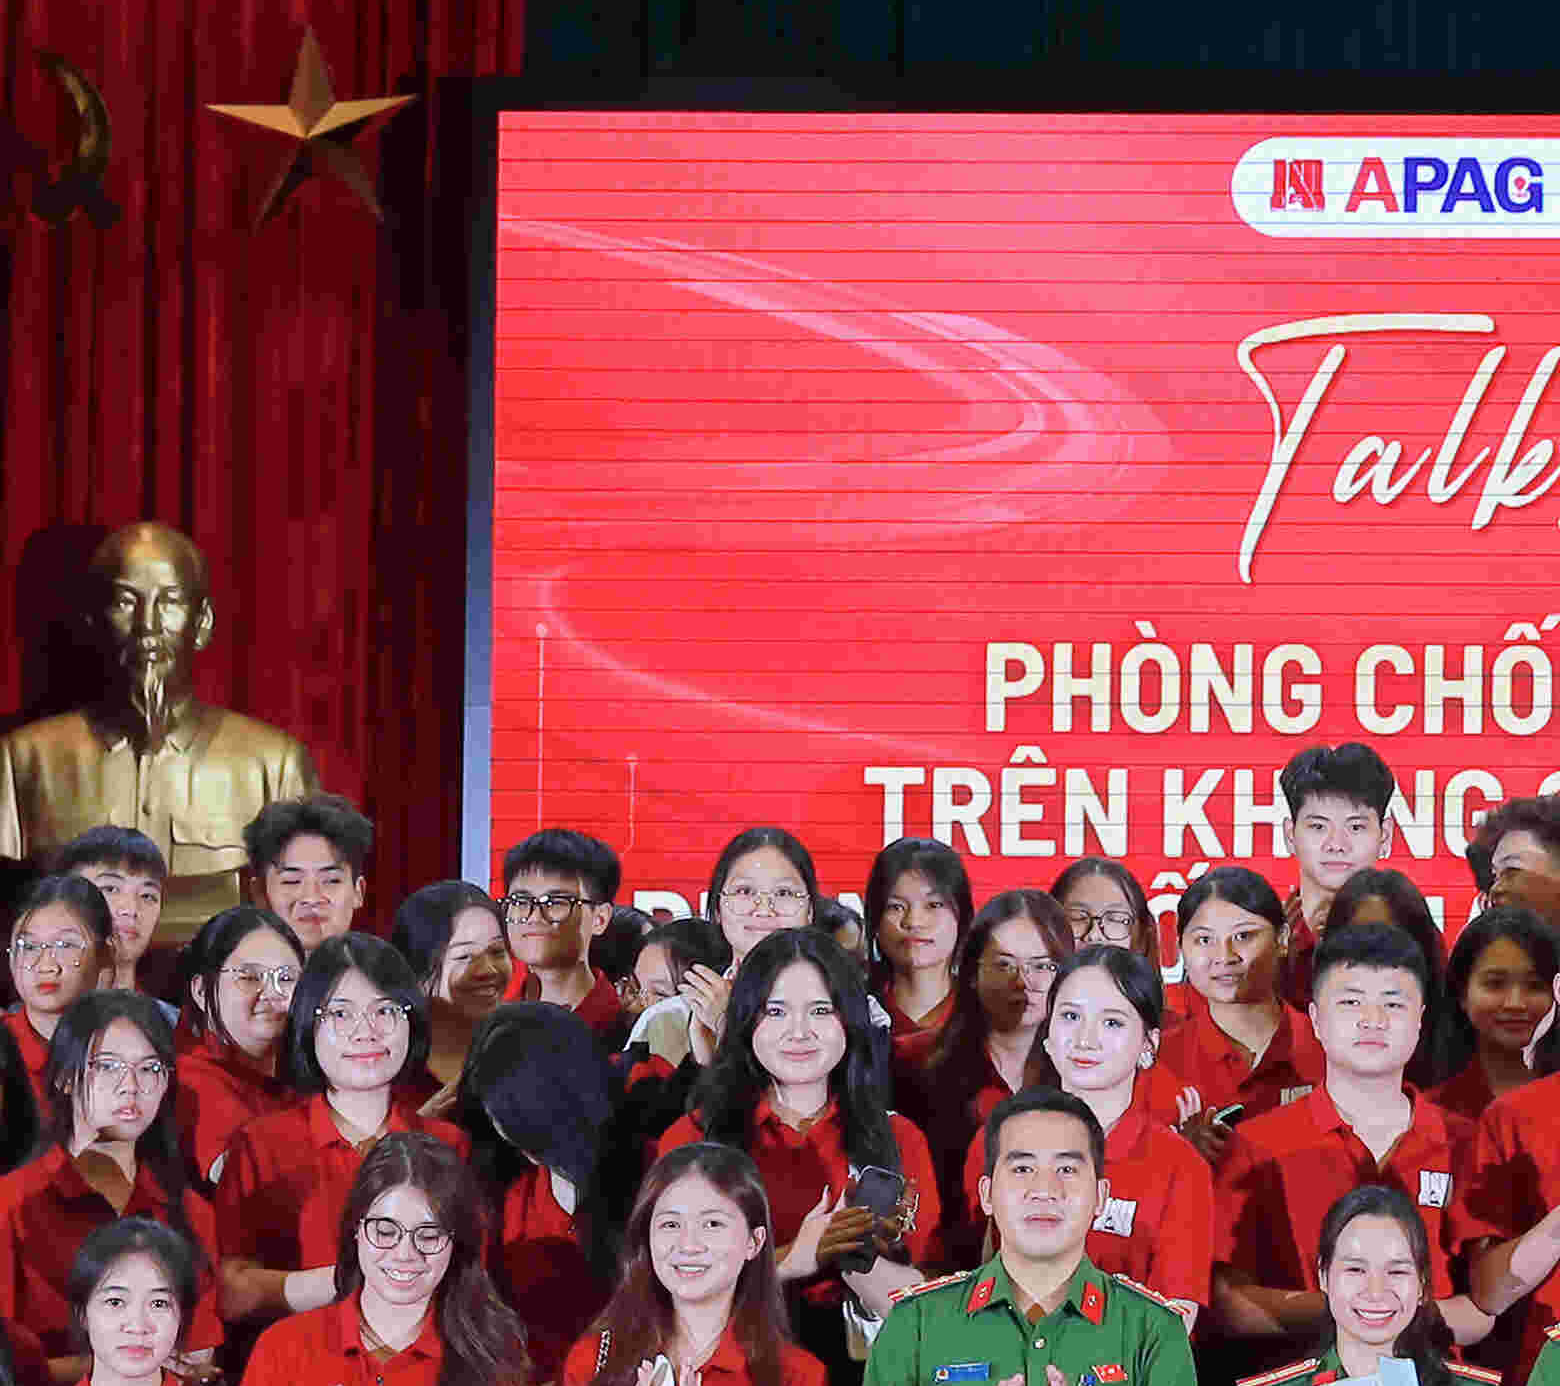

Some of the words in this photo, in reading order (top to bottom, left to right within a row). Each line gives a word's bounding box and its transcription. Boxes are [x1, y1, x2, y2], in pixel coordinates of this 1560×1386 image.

[1344, 156, 1544, 214] APAG
[984, 619, 1323, 736] PHÒNG
[863, 745, 1130, 858] TRÊN
[1162, 768, 1504, 859] KHNG
